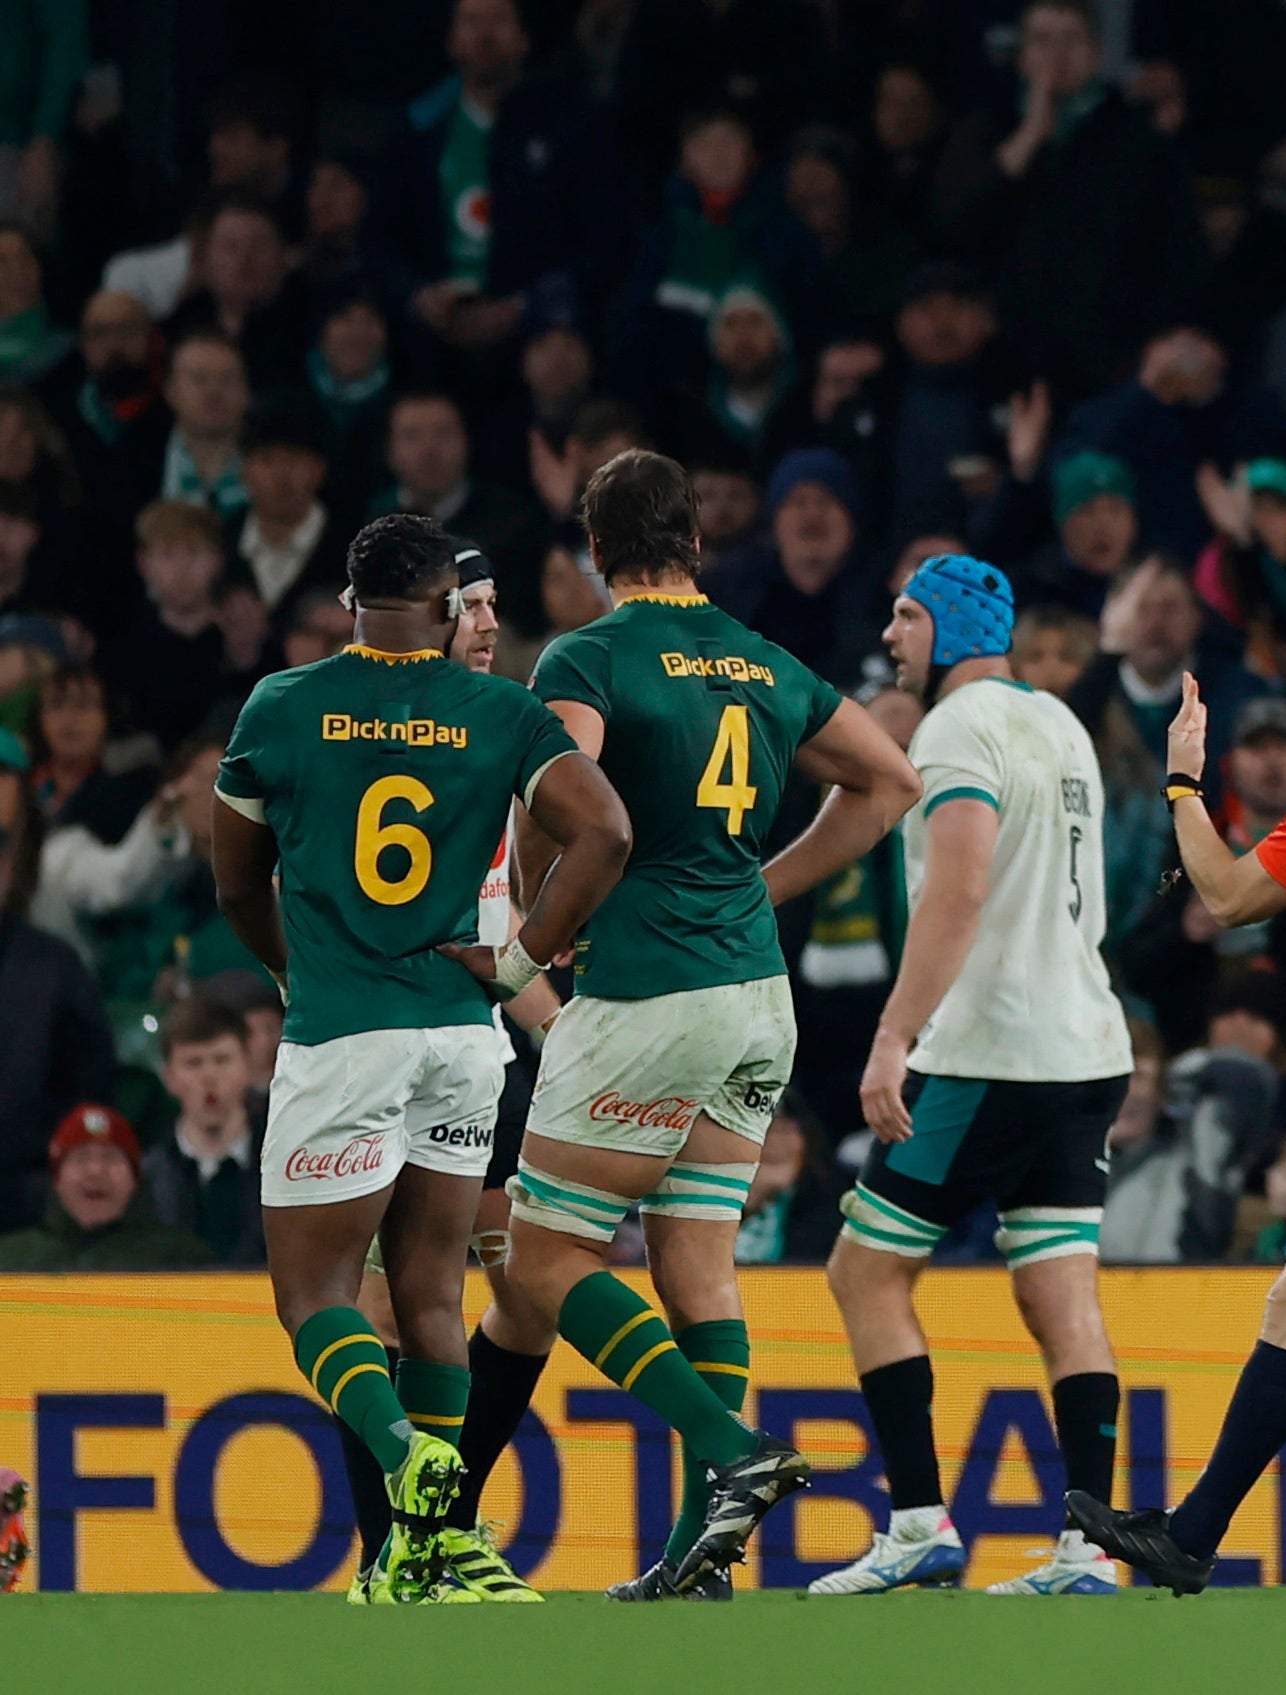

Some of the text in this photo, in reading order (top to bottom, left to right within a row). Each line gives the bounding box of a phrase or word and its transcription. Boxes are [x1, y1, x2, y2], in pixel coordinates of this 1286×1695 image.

[696, 705, 757, 836] 4
[353, 774, 435, 906] 6
[1068, 825, 1083, 925] 5
[429, 1125, 494, 1148] betw
[589, 1091, 699, 1130] Coca-Cola
[285, 1134, 385, 1182] Coca-Cola
